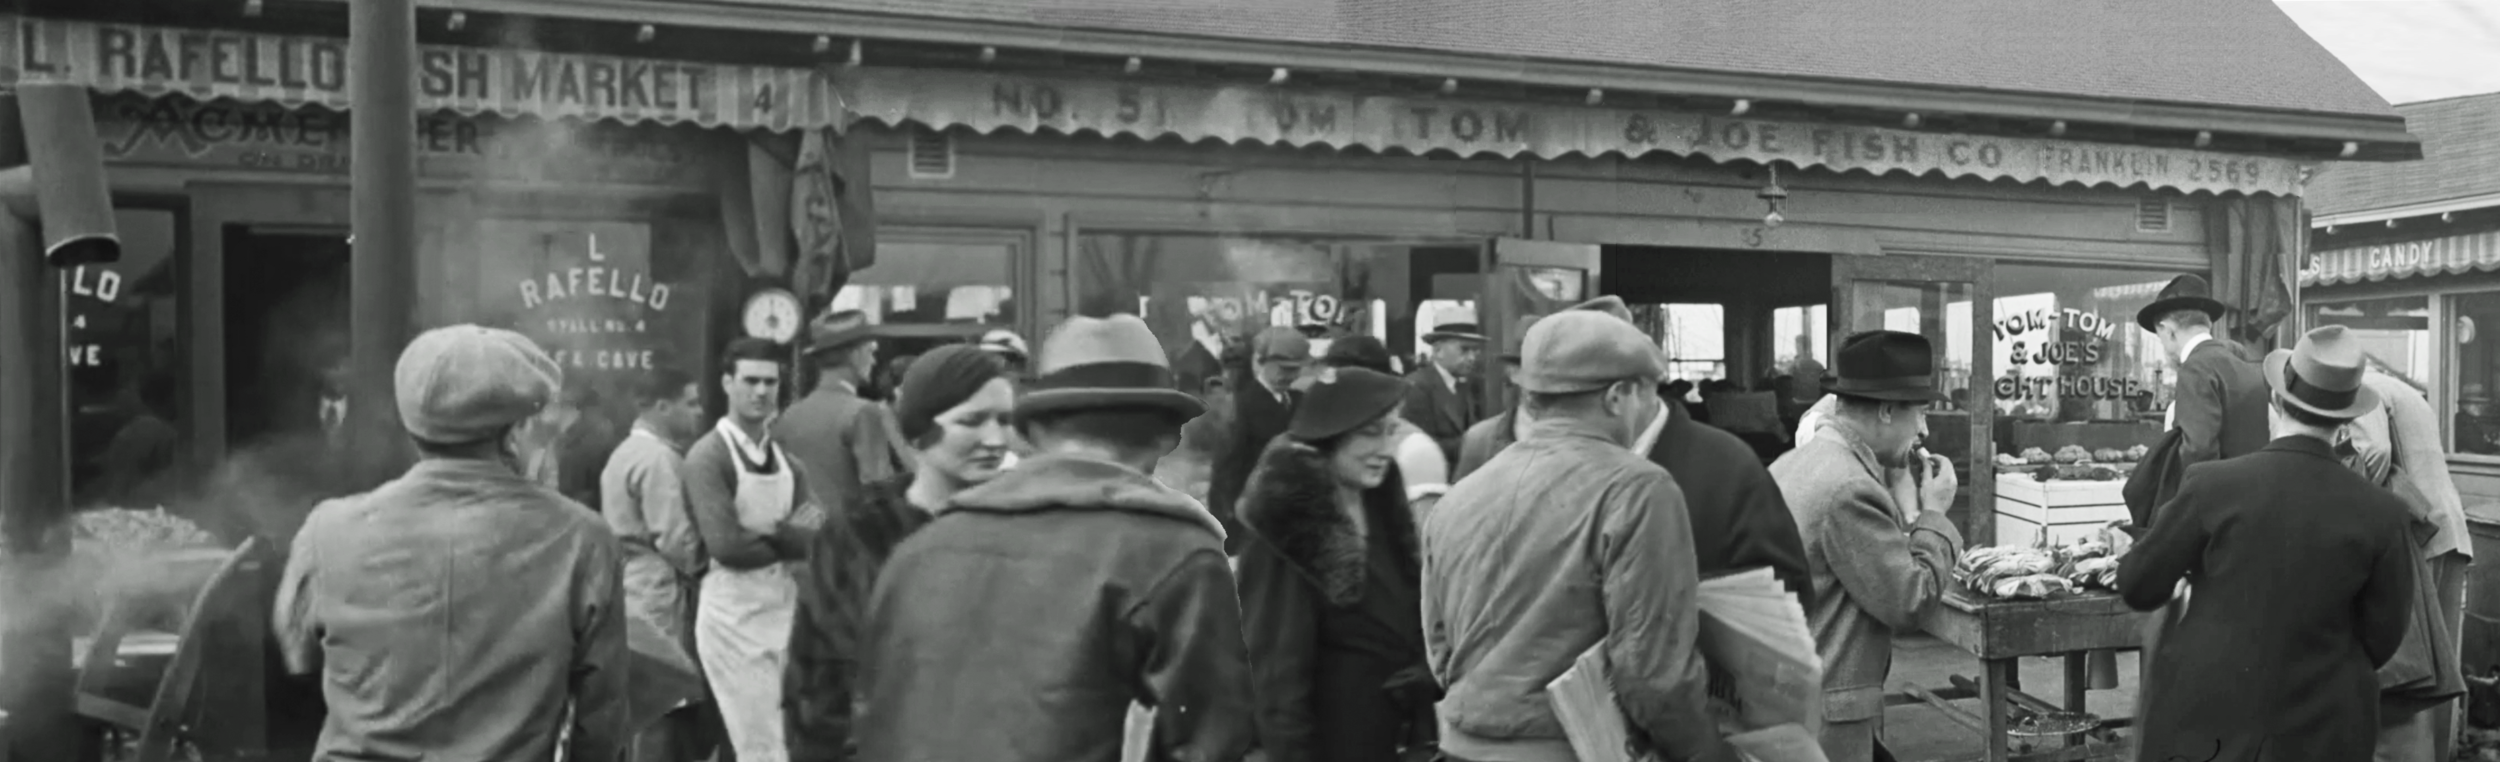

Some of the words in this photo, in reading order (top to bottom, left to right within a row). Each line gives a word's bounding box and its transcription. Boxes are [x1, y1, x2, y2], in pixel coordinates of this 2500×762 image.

[101, 28, 345, 91] RAFELLO
[420, 50, 488, 99] SH
[512, 53, 706, 110] MARKET
[754, 83, 773, 114] 4
[1410, 107, 1530, 143] TOM
[1624, 113, 1656, 145] &
[1687, 116, 1782, 152] JOE
[1812, 127, 1919, 163] FISH
[2043, 145, 2169, 175] FRANKLIN
[2188, 157, 2260, 185] 2569
[589, 232, 605, 262] L
[2370, 240, 2433, 269] CANDY
[73, 264, 121, 302] LO
[519, 267, 670, 312] RAFELLO
[634, 318, 646, 333] 4
[1993, 307, 2117, 343] TOM-TOM
[69, 344, 102, 367] VE
[596, 348, 655, 371] CAVE
[2010, 340, 2029, 366] &
[2033, 340, 2100, 366] JOE'S
[1994, 374, 2053, 400] GHT
